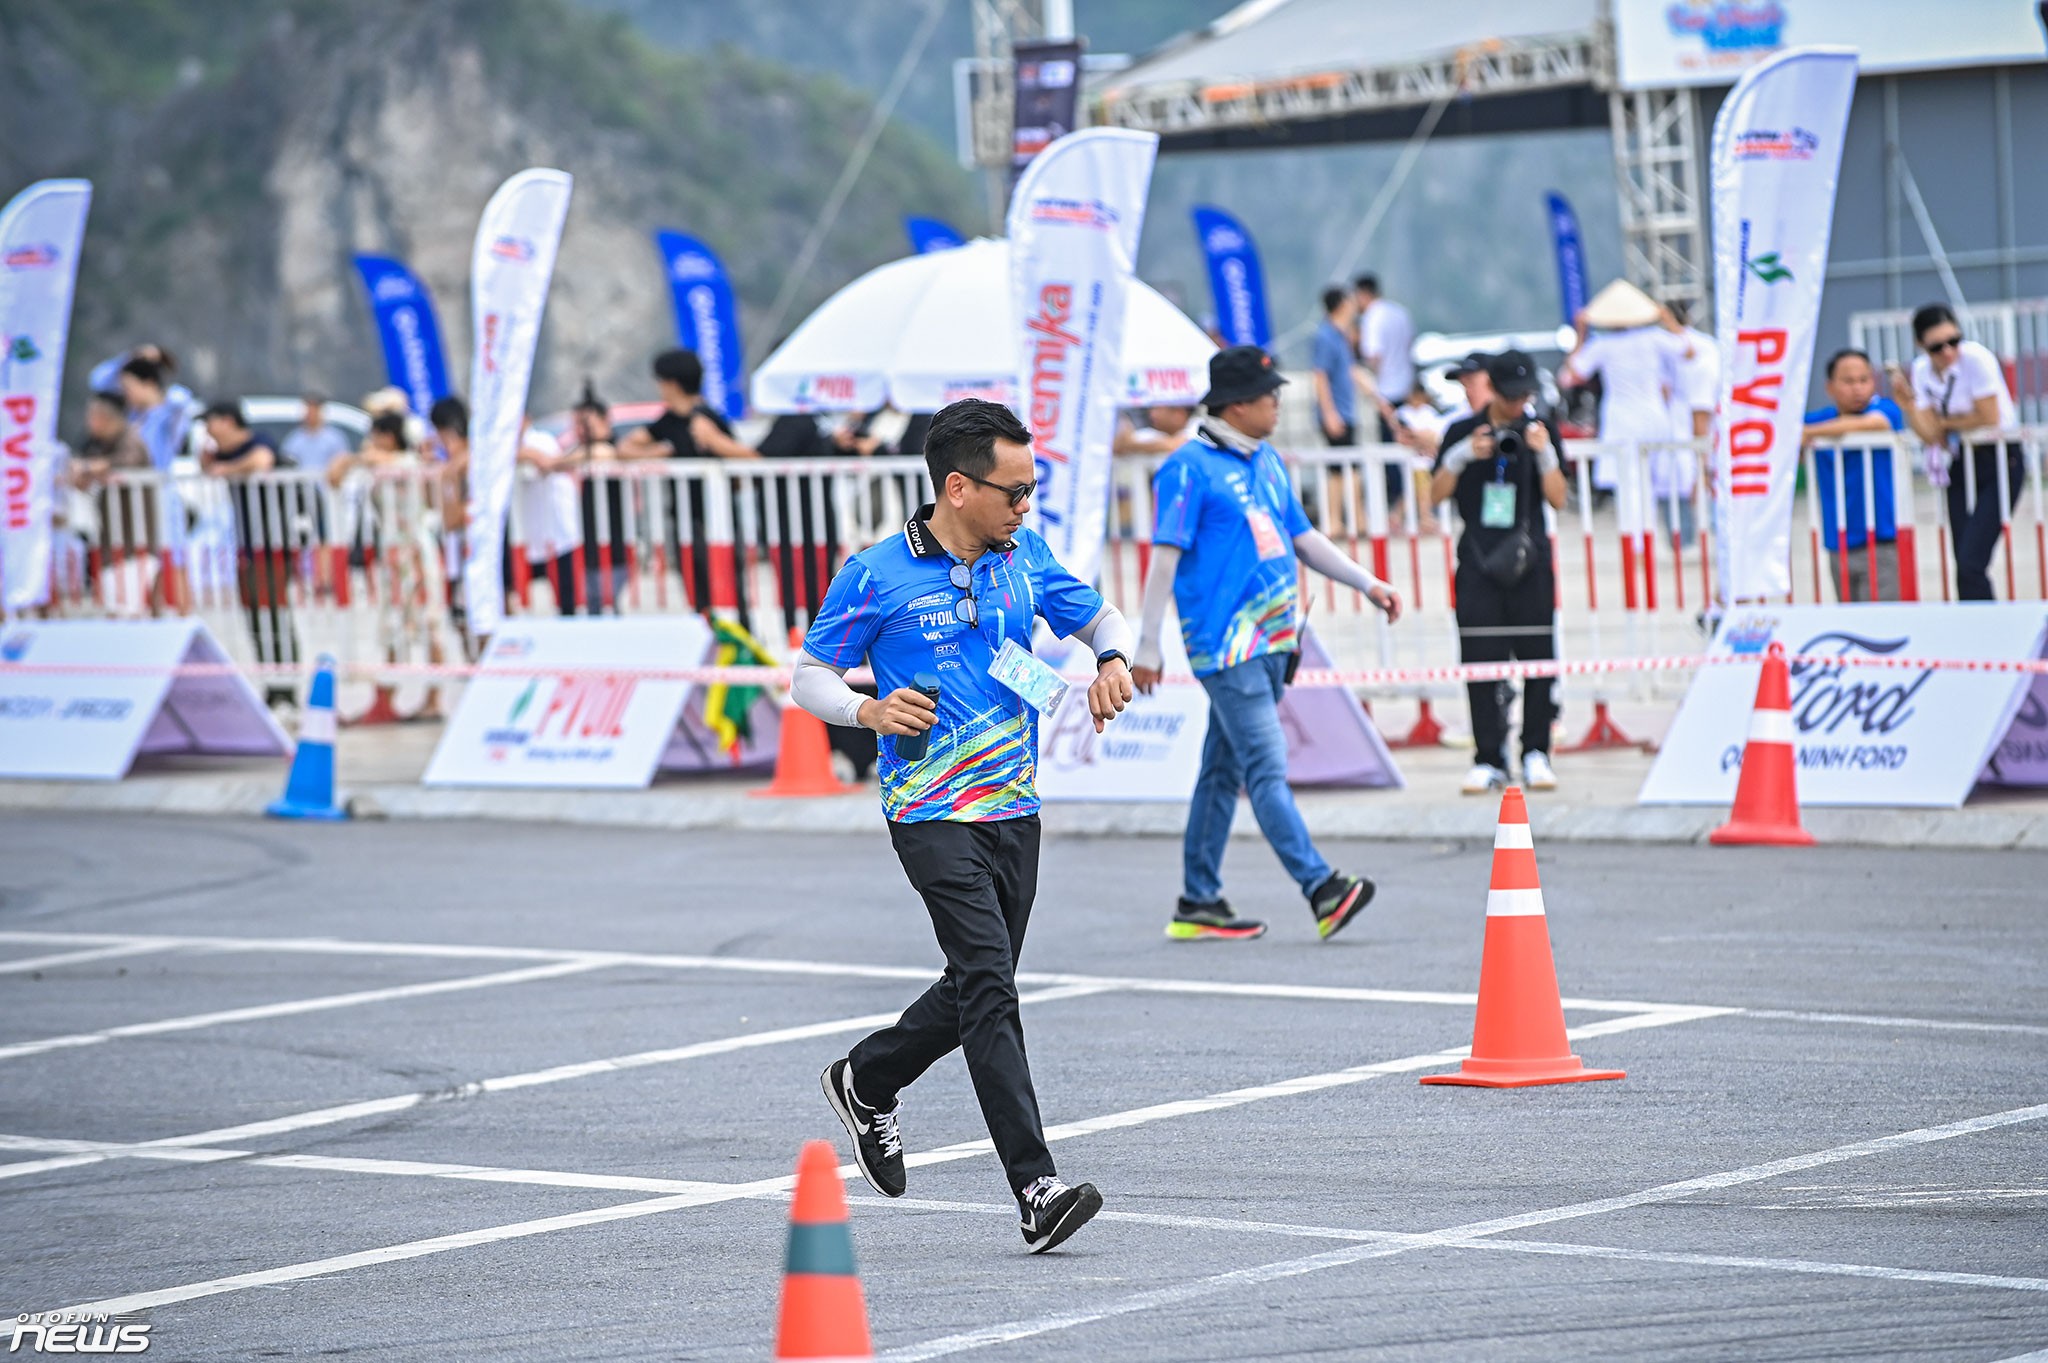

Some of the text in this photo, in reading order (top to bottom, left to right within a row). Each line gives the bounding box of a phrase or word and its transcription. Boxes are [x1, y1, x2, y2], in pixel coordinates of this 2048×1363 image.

[814, 373, 856, 399] PVOIL
[909, 520, 927, 554] OTOFUN
[919, 610, 957, 628] PVOIL
[1788, 631, 1932, 735] Ford
[535, 672, 640, 738] PVOIL
[1848, 745, 1908, 770] FORD
